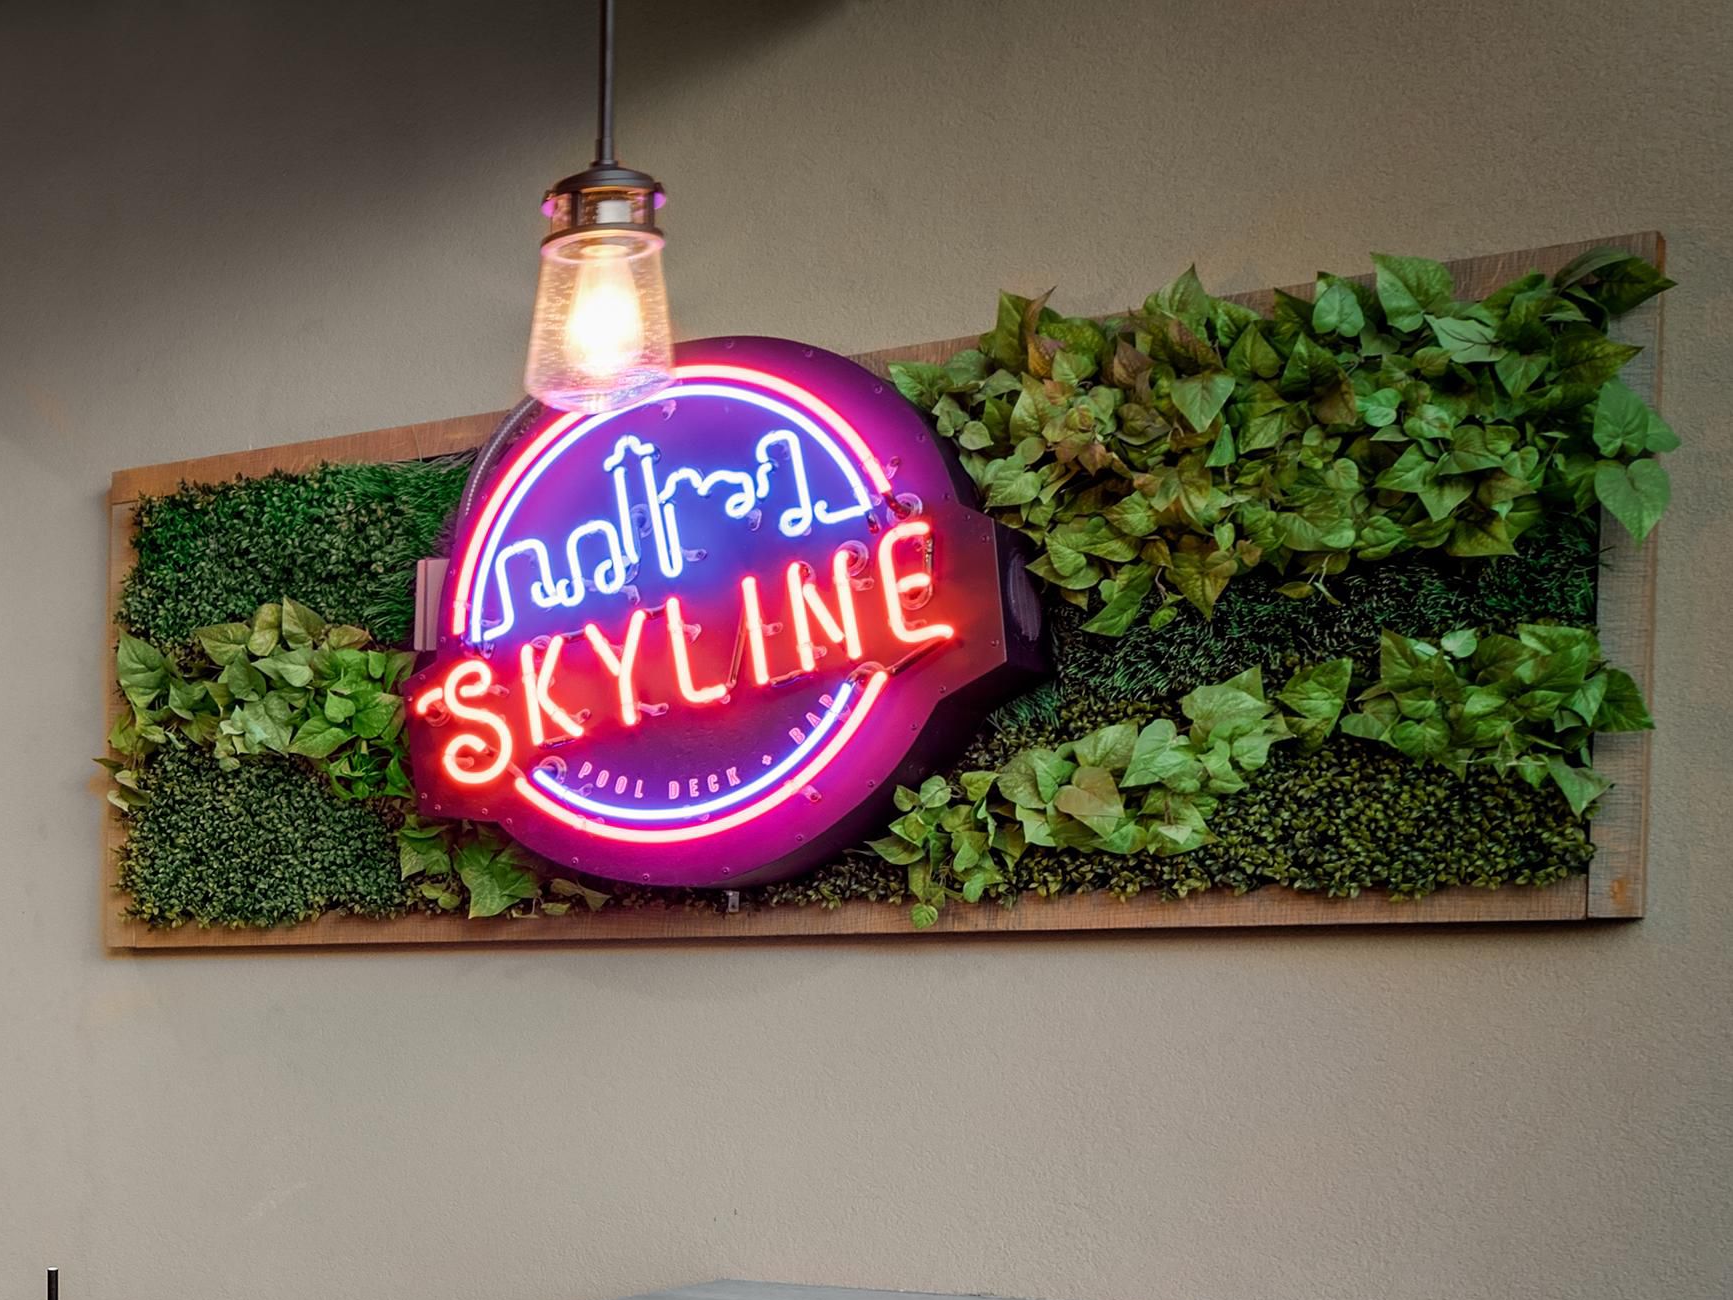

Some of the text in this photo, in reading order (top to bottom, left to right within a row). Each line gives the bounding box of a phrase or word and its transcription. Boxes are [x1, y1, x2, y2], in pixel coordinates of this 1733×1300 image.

[414, 518, 956, 787] SKYLINE
[788, 693, 837, 745] BAR
[577, 761, 741, 800] POOL DECK
